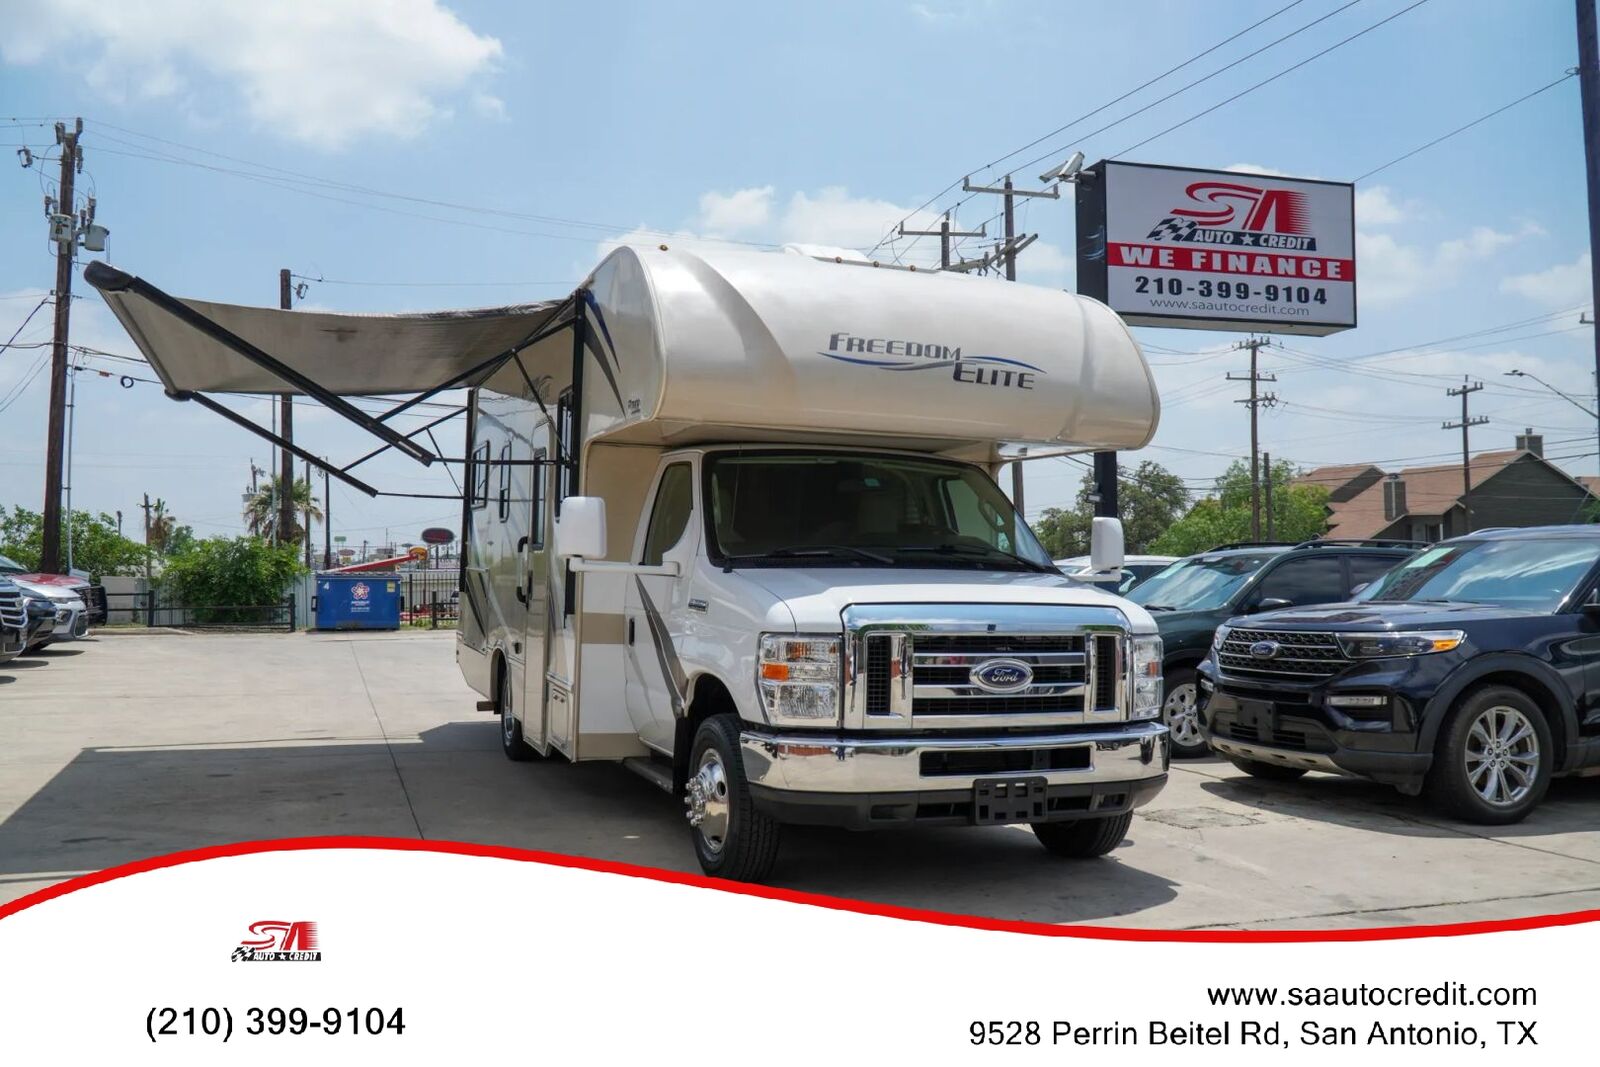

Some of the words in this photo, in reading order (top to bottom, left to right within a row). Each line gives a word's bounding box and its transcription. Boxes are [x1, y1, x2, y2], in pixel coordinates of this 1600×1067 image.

[1194, 229, 1234, 245] AUTO
[1259, 236, 1311, 250] CREDIT
[1120, 246, 1175, 267] WE
[1191, 251, 1342, 279] FINANCE
[1135, 276, 1327, 305] 210-399-9104
[1150, 299, 1310, 316] www.saautocredit.com
[991, 668, 1019, 682] Ford
